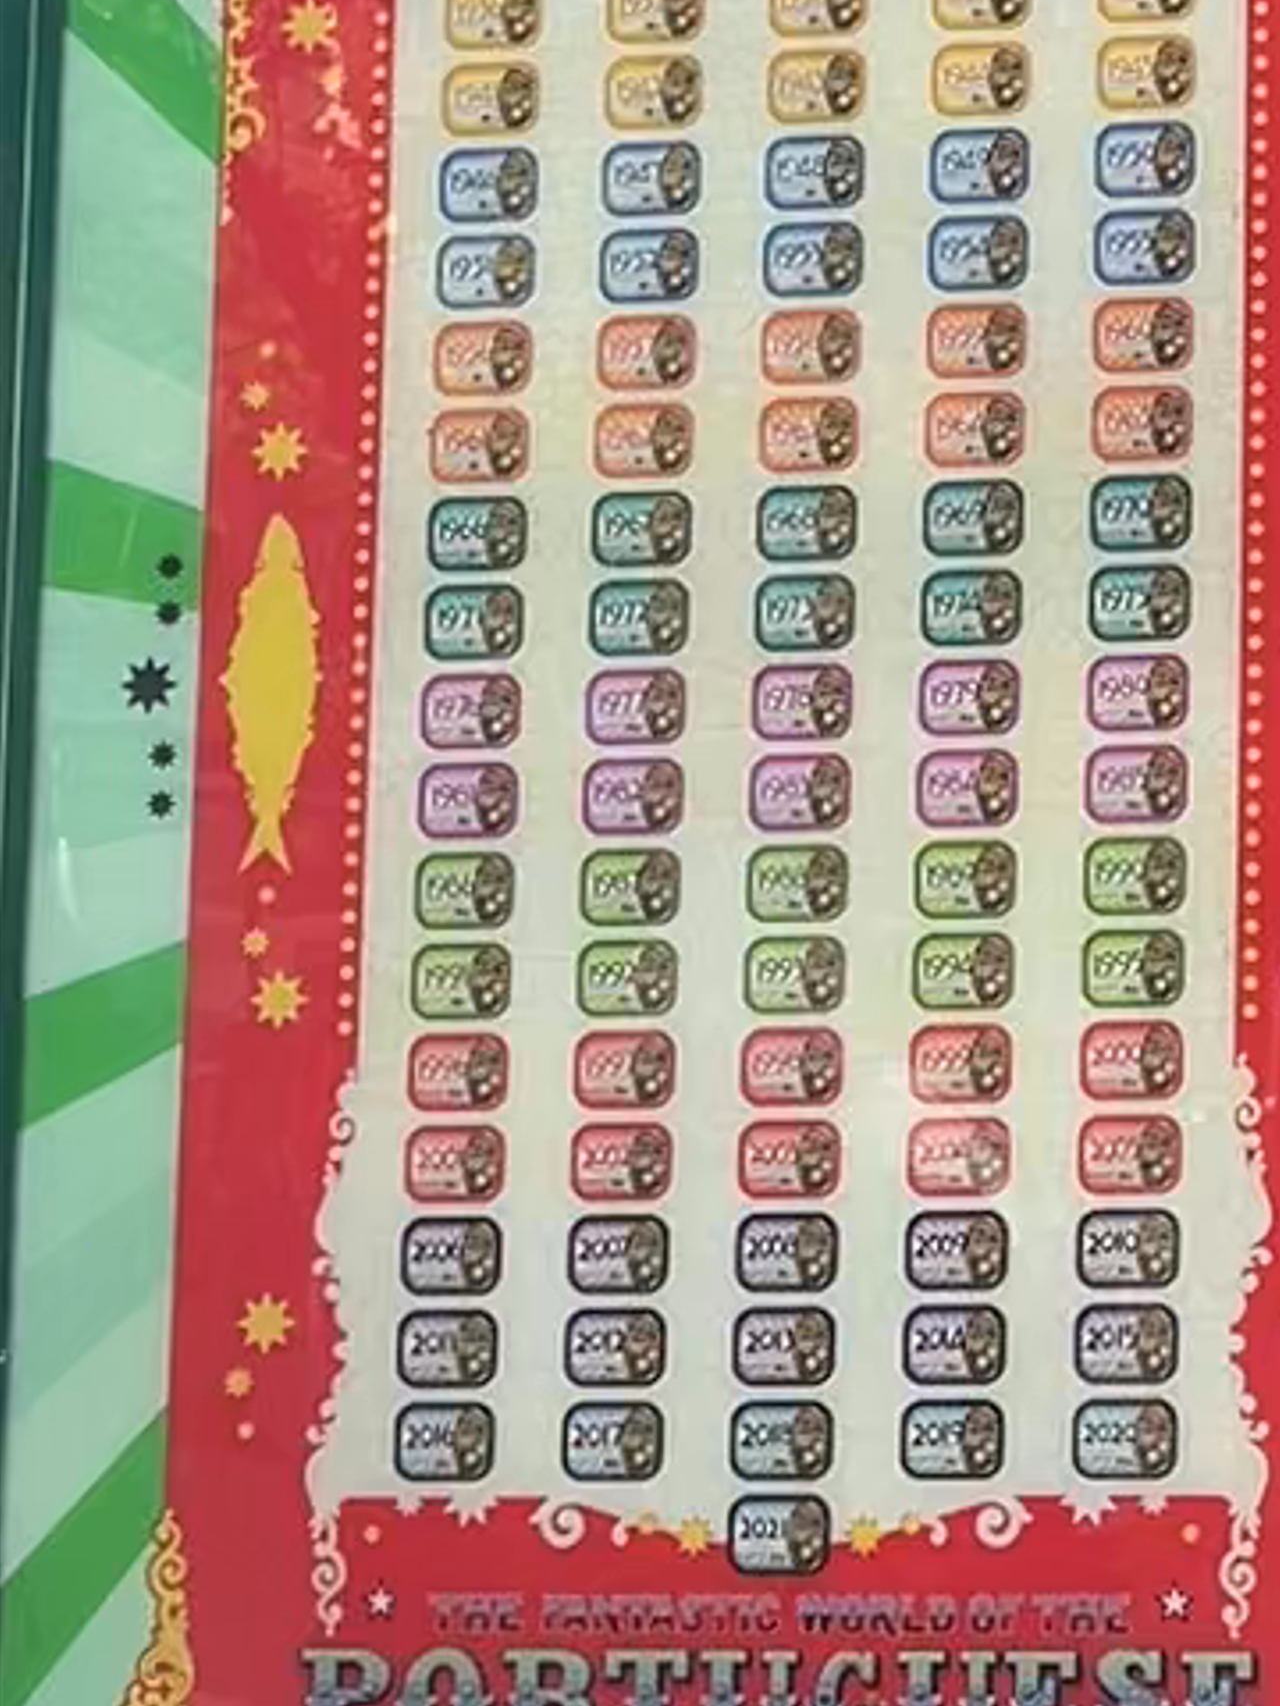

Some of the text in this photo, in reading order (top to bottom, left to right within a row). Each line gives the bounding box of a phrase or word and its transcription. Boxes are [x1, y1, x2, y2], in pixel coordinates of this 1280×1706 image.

[572, 1421, 623, 1447] 2017
[428, 1592, 1131, 1633] THE FANTASTIC WORLD OF THE
